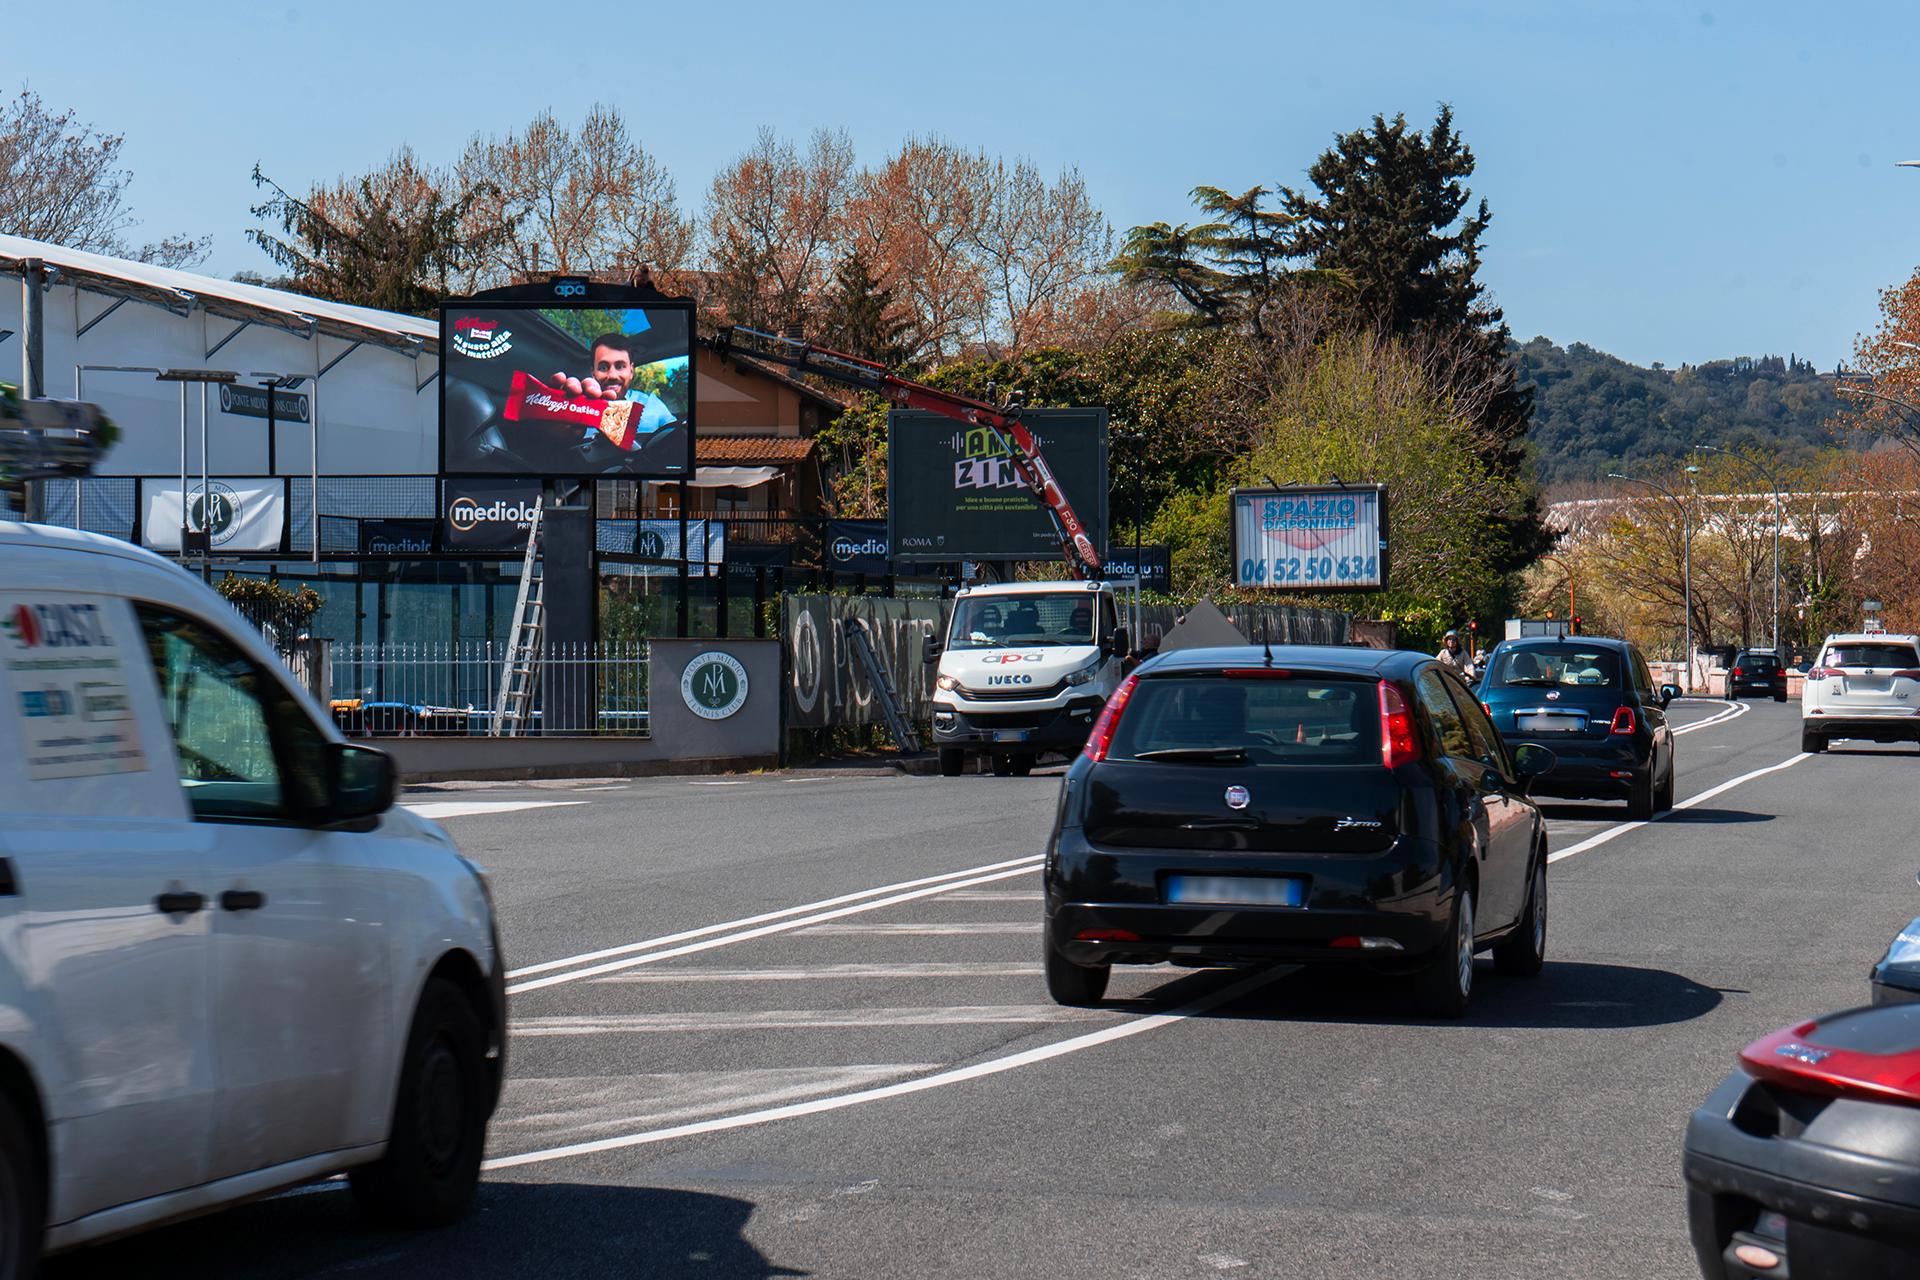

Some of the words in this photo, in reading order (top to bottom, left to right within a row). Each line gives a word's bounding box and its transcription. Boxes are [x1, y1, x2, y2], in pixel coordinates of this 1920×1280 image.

[554, 285, 585, 297] apa
[462, 340, 490, 351] gusto
[490, 330, 512, 348] alla
[467, 341, 513, 359] mattina
[525, 393, 568, 412] Kellogg's
[569, 404, 600, 417] Oaties
[455, 501, 543, 521] mediola
[1262, 498, 1356, 519] SPAZIO
[1062, 510, 1078, 531] F30
[1263, 518, 1356, 531] DISPONIBILE
[902, 538, 932, 546] ROMA
[1241, 558, 1268, 582] 06
[1273, 557, 1301, 581] 52
[1304, 556, 1332, 580] 50
[1337, 555, 1377, 580] 634
[685, 654, 711, 677] PONTE
[716, 655, 744, 677] MILVIO
[981, 653, 1044, 664] apa
[988, 674, 1032, 685] IVECO
[687, 698, 720, 718] TENNIS
[722, 697, 743, 716] CLUB
